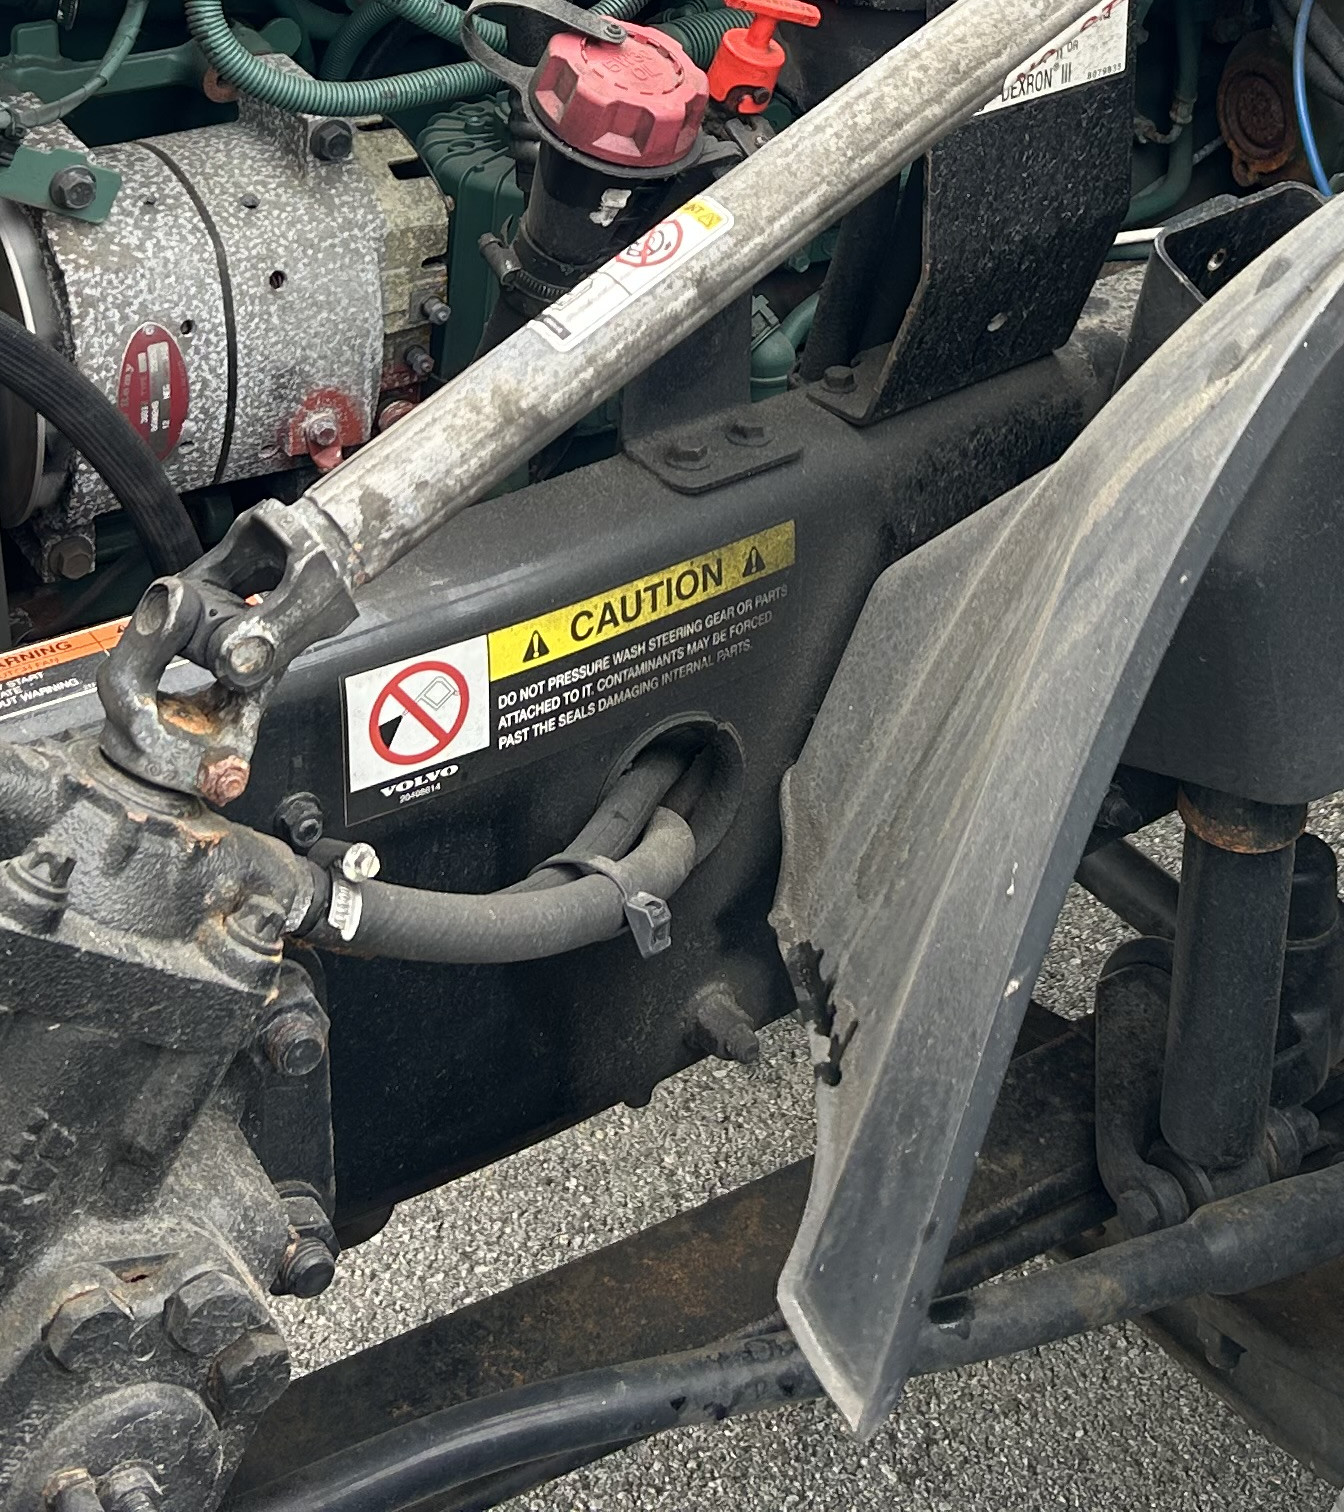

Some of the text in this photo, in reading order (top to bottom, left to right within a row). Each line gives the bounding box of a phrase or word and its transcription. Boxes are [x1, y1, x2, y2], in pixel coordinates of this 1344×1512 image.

[1067, 40, 1079, 53] OR
[120, 363, 134, 407] Remy
[570, 558, 723, 642] CAUTION
[498, 584, 788, 709] DO NOT PRESSURE WASH STEERING GEAR OR PARTS
[6, 672, 45, 688] START
[19, 678, 80, 702] WARNING
[497, 611, 773, 731] ATTACHED TO IT. CONTAMINANTS MAY BE FORCED
[498, 730, 530, 750] PAST
[532, 717, 556, 738] THE
[558, 701, 596, 727] SEALS
[598, 678, 660, 712] DAMAGING
[661, 655, 715, 687] INTERNAL
[380, 764, 459, 797] VOLVO
